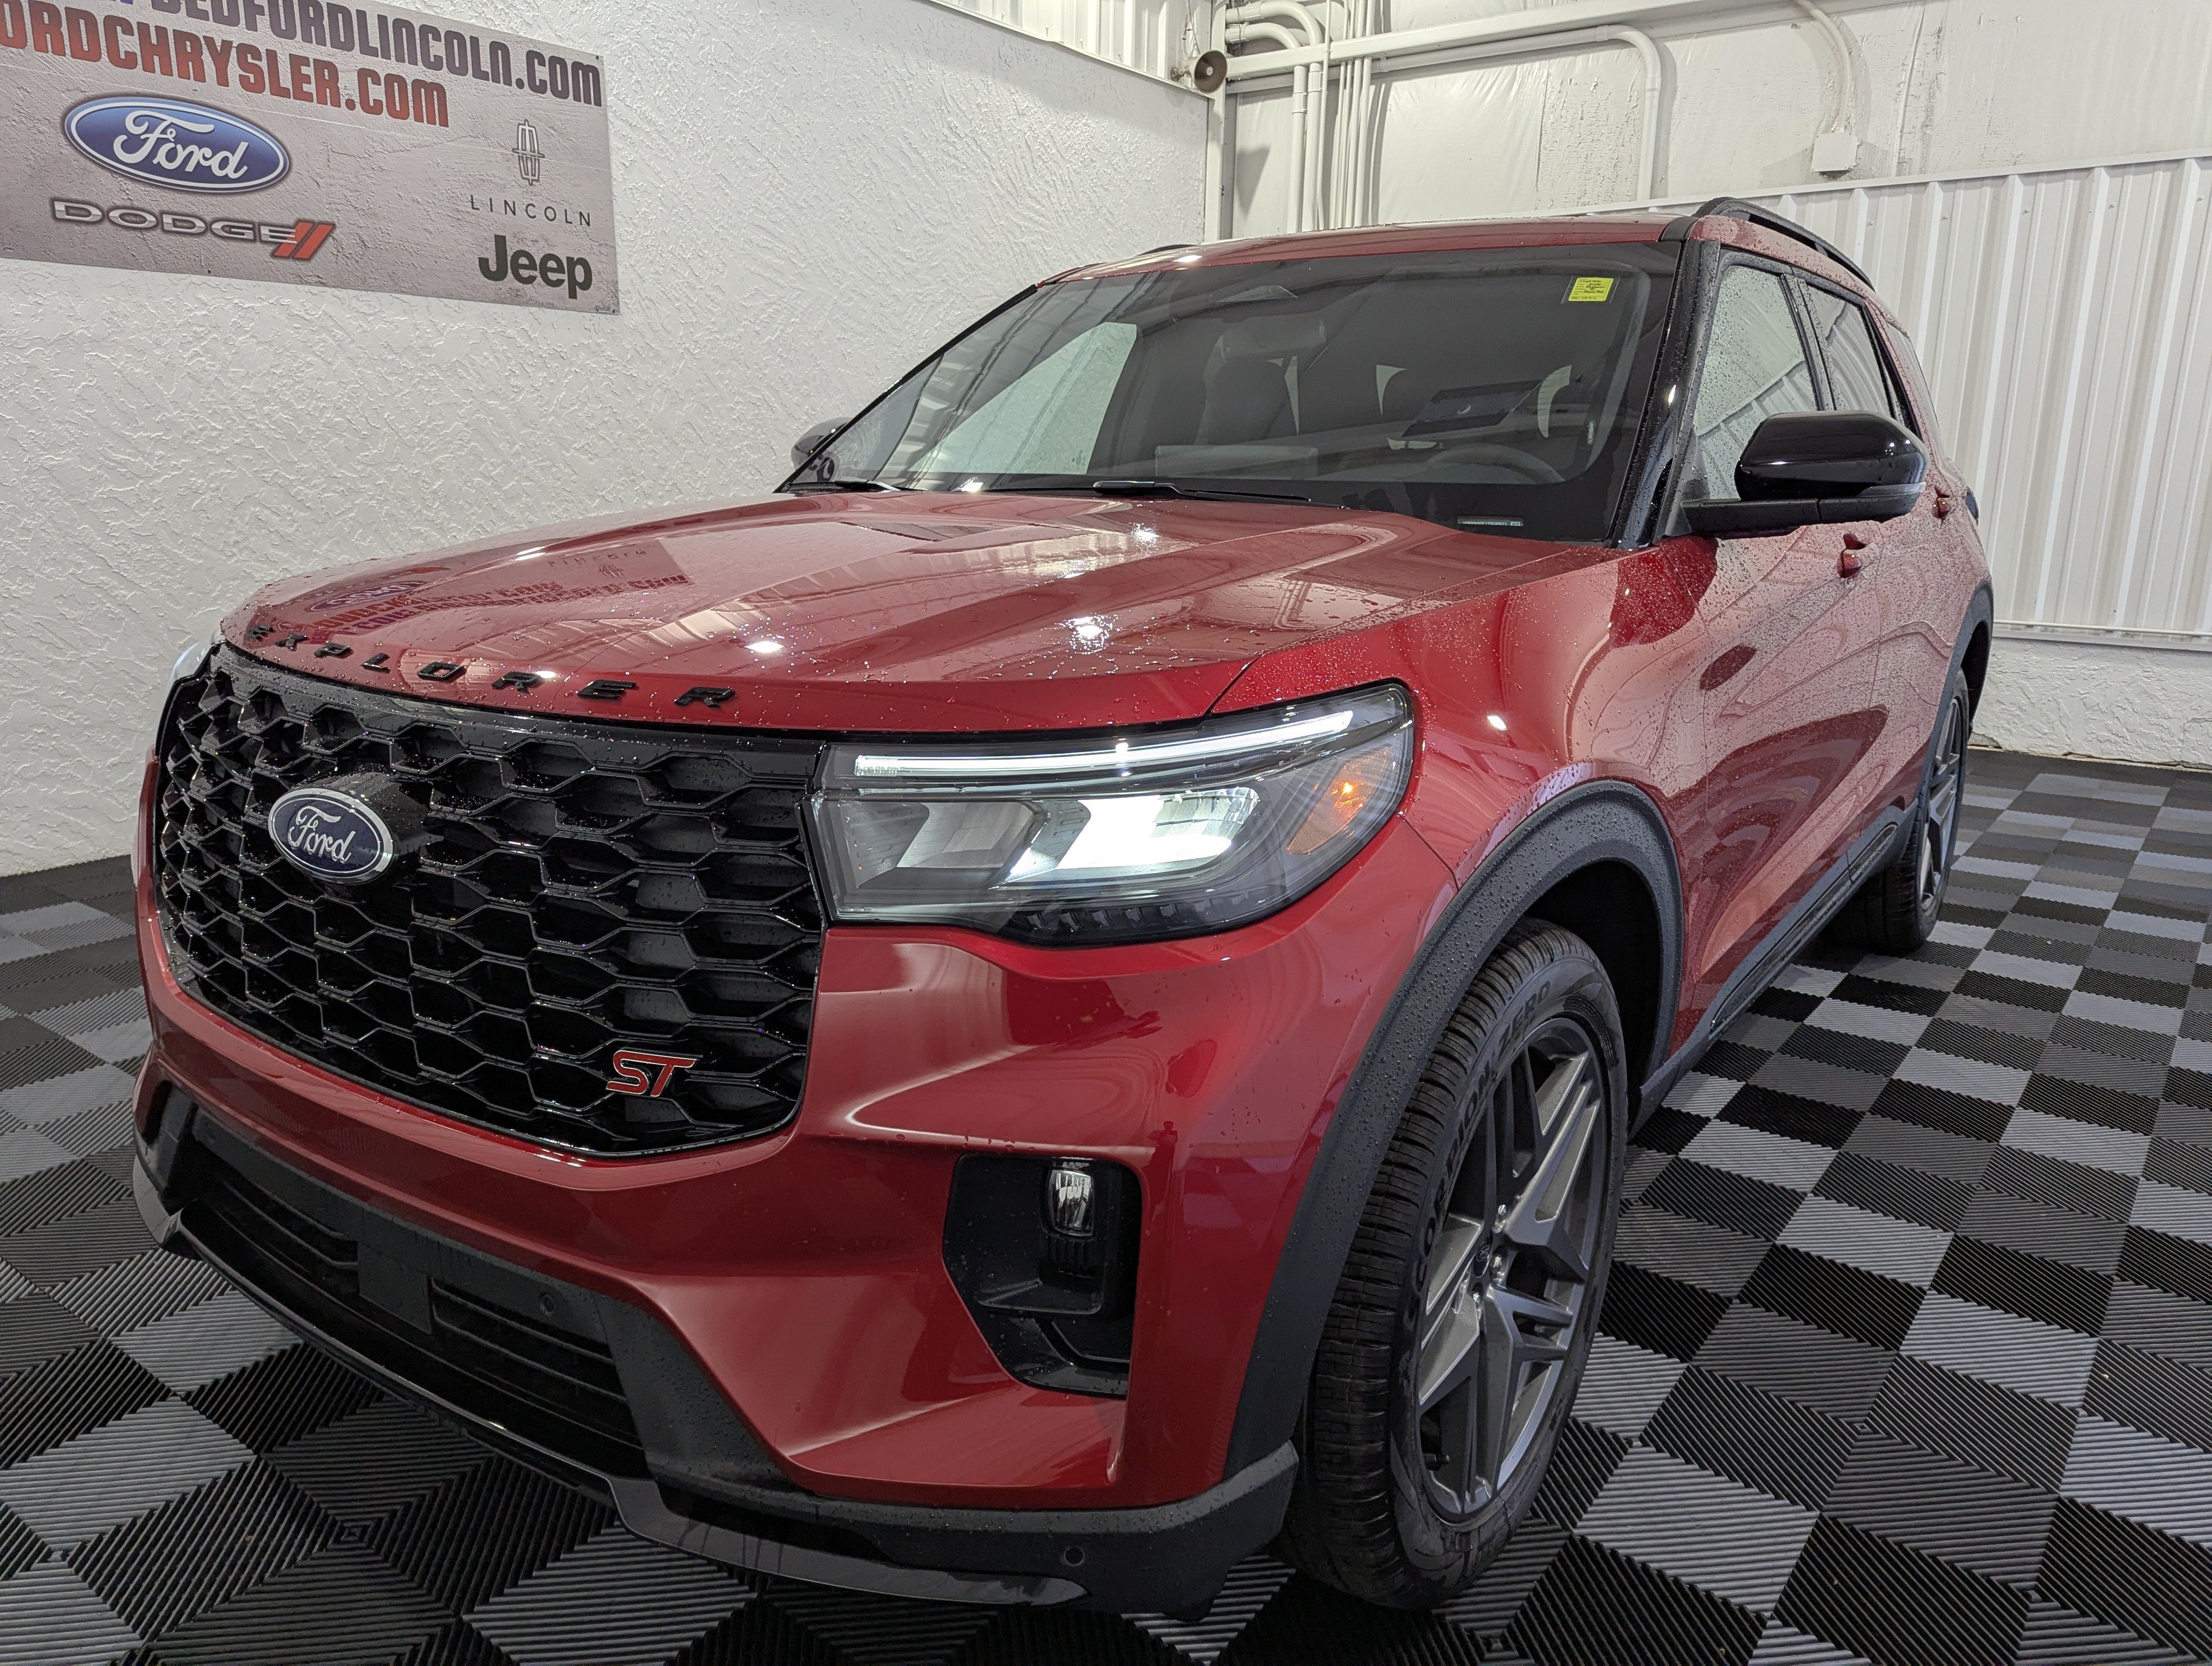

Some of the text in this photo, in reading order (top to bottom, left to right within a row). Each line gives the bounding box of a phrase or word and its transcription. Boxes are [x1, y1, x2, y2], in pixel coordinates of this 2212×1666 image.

[151, 0, 602, 107] DFORDLINCOLN.COM
[113, 110, 248, 179] Ford
[55, 201, 298, 245] DODGE
[471, 195, 590, 227] LINCOLN
[478, 234, 593, 299] Jeep
[246, 623, 736, 709] EXPLORER
[288, 805, 356, 864] Ford
[606, 1050, 697, 1097] ST
